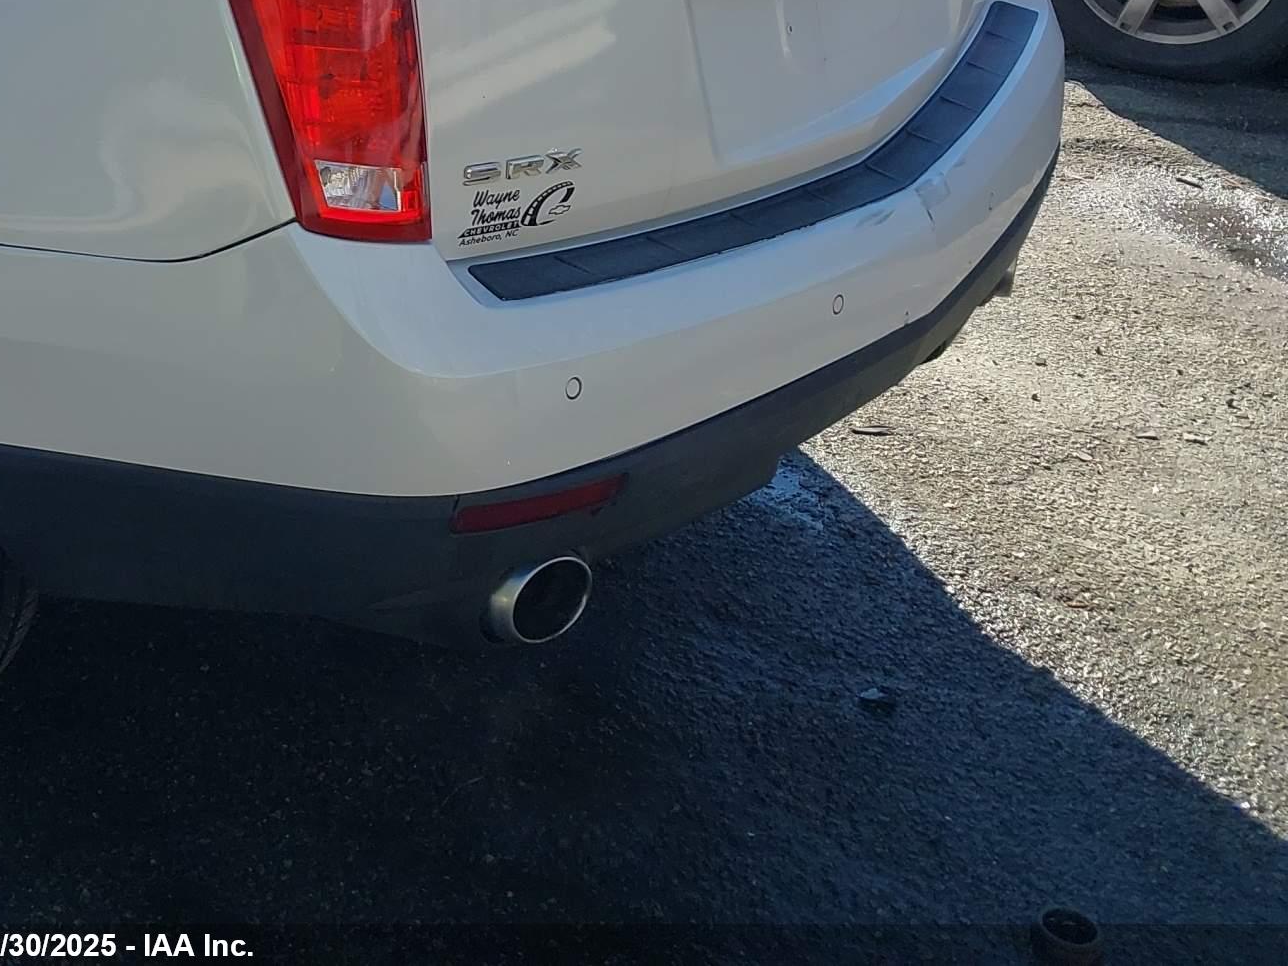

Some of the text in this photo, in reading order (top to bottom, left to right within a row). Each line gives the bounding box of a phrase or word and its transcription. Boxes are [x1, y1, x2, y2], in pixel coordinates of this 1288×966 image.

[462, 147, 582, 186] SRX
[472, 189, 520, 210] Wayne
[470, 206, 521, 226] Thomas
[458, 229, 519, 246] Asheboro, NC
[463, 221, 519, 237] CHEVROLET
